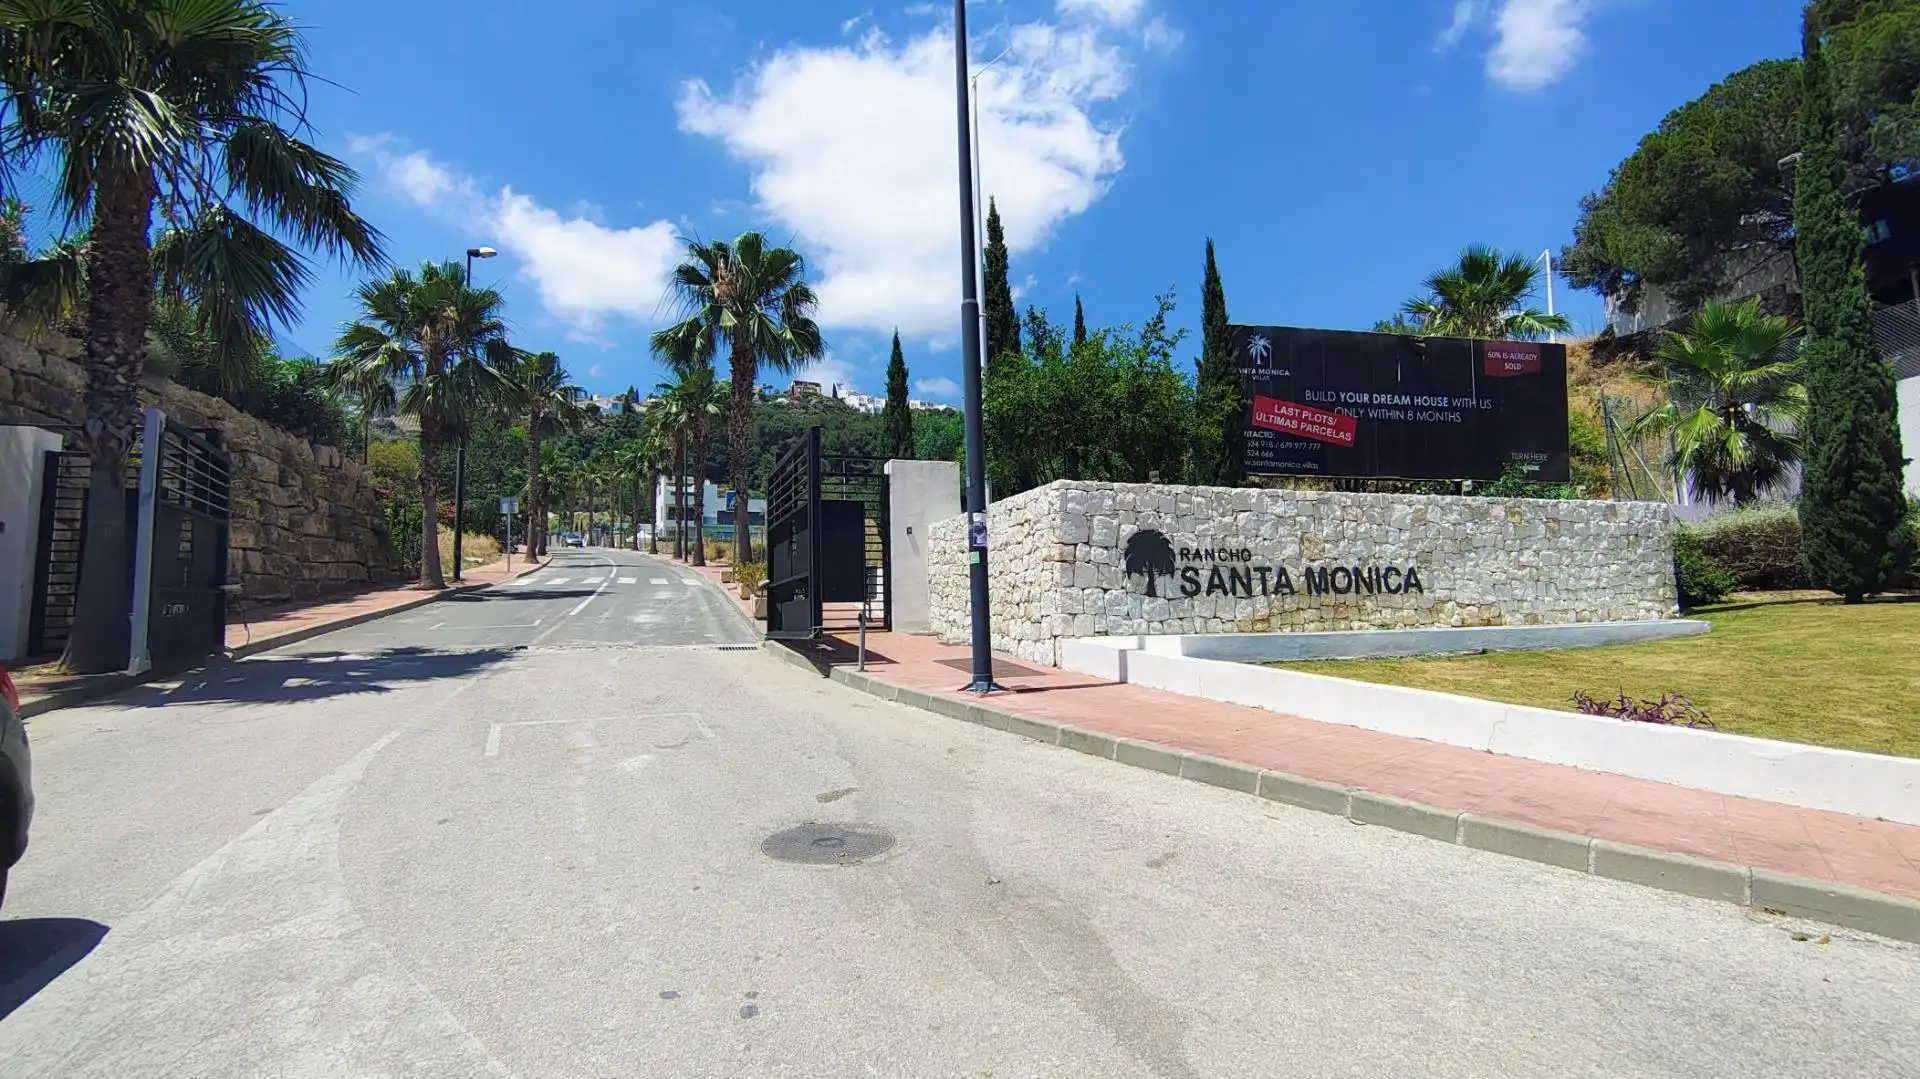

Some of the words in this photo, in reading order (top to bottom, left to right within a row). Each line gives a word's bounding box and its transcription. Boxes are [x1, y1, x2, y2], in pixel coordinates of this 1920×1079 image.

[1502, 351, 1508, 359] IS
[1509, 352, 1537, 361] ALREADY
[1258, 368, 1291, 376] MONICA
[1504, 362, 1522, 370] SOLD
[1305, 390, 1337, 402] BUILD
[1339, 392, 1369, 404] YOUR
[1373, 394, 1412, 406] DREAM
[1414, 395, 1449, 407] HOUSE
[1451, 397, 1477, 409] WITH
[1479, 399, 1492, 409] US
[1274, 404, 1301, 418] LAST
[1302, 410, 1337, 426] PLOTS/
[1334, 407, 1365, 419] ONLY
[1368, 409, 1405, 421] WITHIN
[1407, 410, 1414, 421] 8
[1416, 410, 1462, 423] MONTHS
[1243, 430, 1276, 439] NTACTO:
[1300, 421, 1352, 441] PARCELAS
[1511, 452, 1530, 460] TURN
[1530, 452, 1548, 461] HERE
[1243, 459, 1319, 469] w.santamonica.villas
[1180, 547, 1252, 563] RANCHO
[1179, 566, 1296, 598] SANTA
[1303, 565, 1425, 596] MONICA
